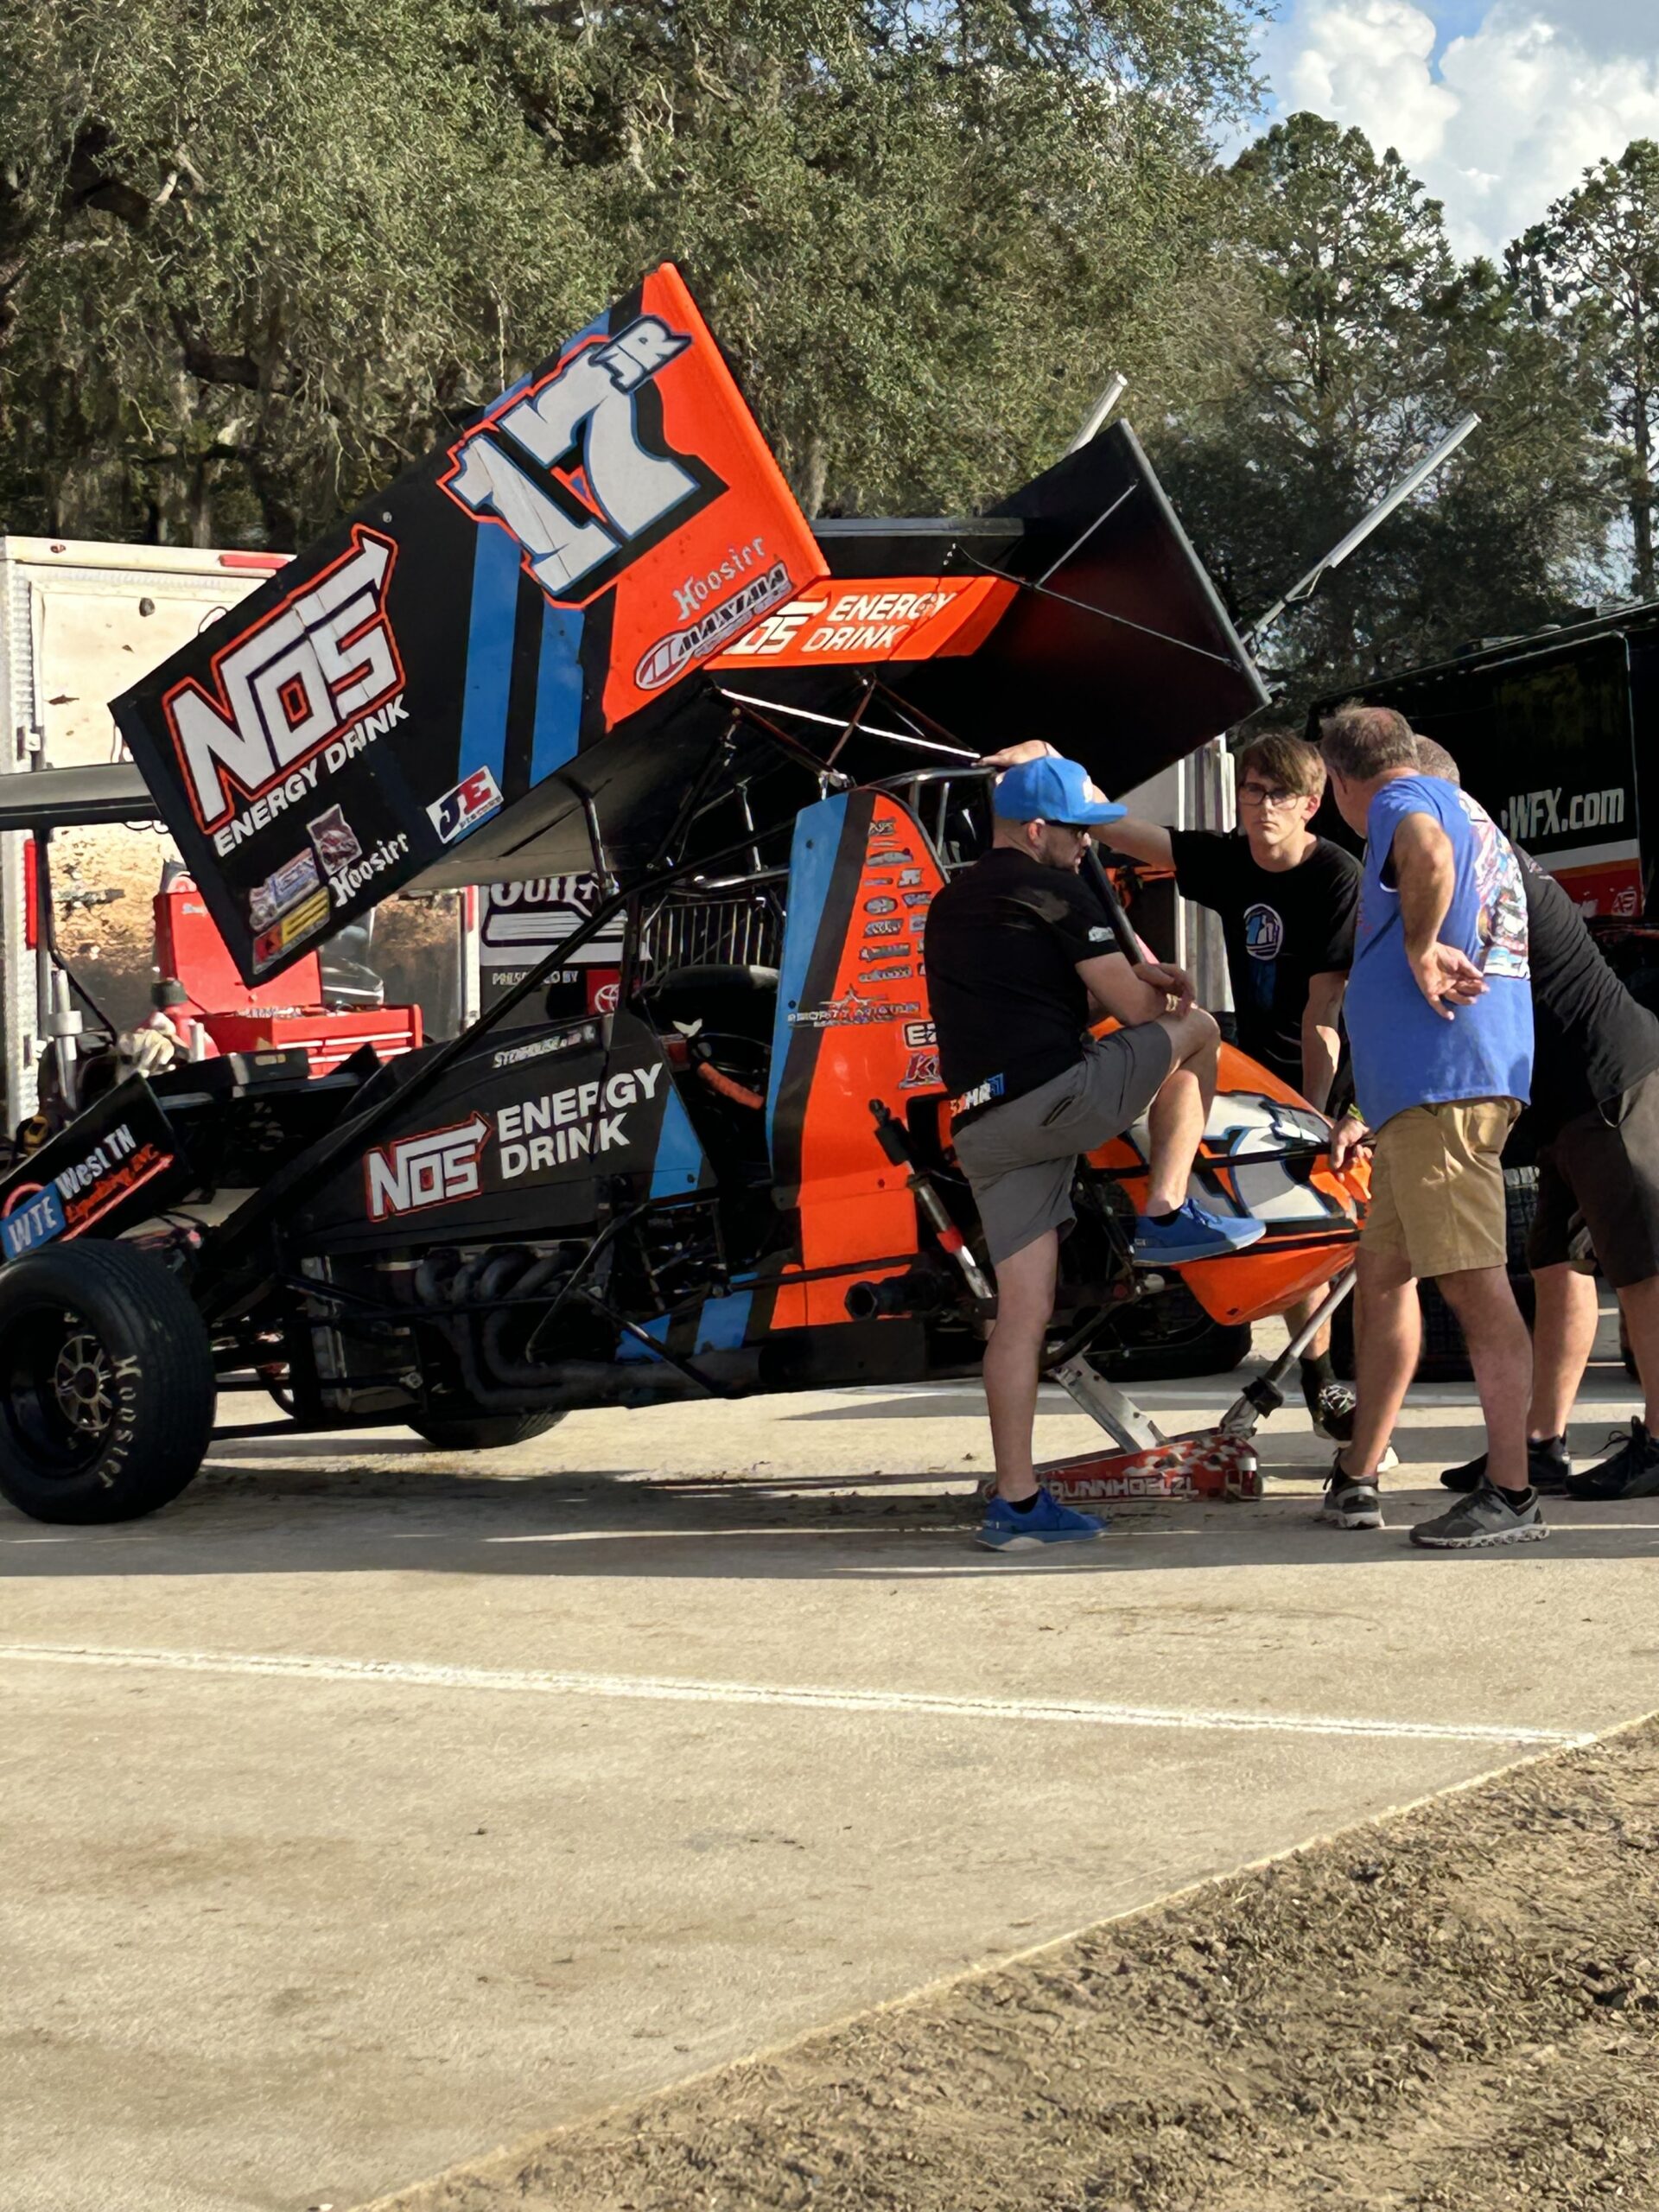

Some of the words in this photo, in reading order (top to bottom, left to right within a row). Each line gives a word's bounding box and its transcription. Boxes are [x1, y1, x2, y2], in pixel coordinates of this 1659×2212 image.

[449, 347, 701, 595] 17
[591, 316, 693, 392] JR
[723, 596, 828, 655] OS
[801, 624, 912, 652] DRINK
[827, 592, 957, 622] ENERGY
[169, 529, 401, 828] NOS
[212, 761, 320, 857] ENERGY
[324, 694, 410, 774] DRINK
[439, 770, 493, 839] JE
[497, 1063, 663, 1142] ENERGY
[366, 1114, 489, 1218] NOS
[499, 1112, 631, 1179] DRINK
[8, 1196, 57, 1253] WTE
[103, 1124, 137, 1160] TN
[1042, 1477, 1199, 1498] RUNNHOELZL
